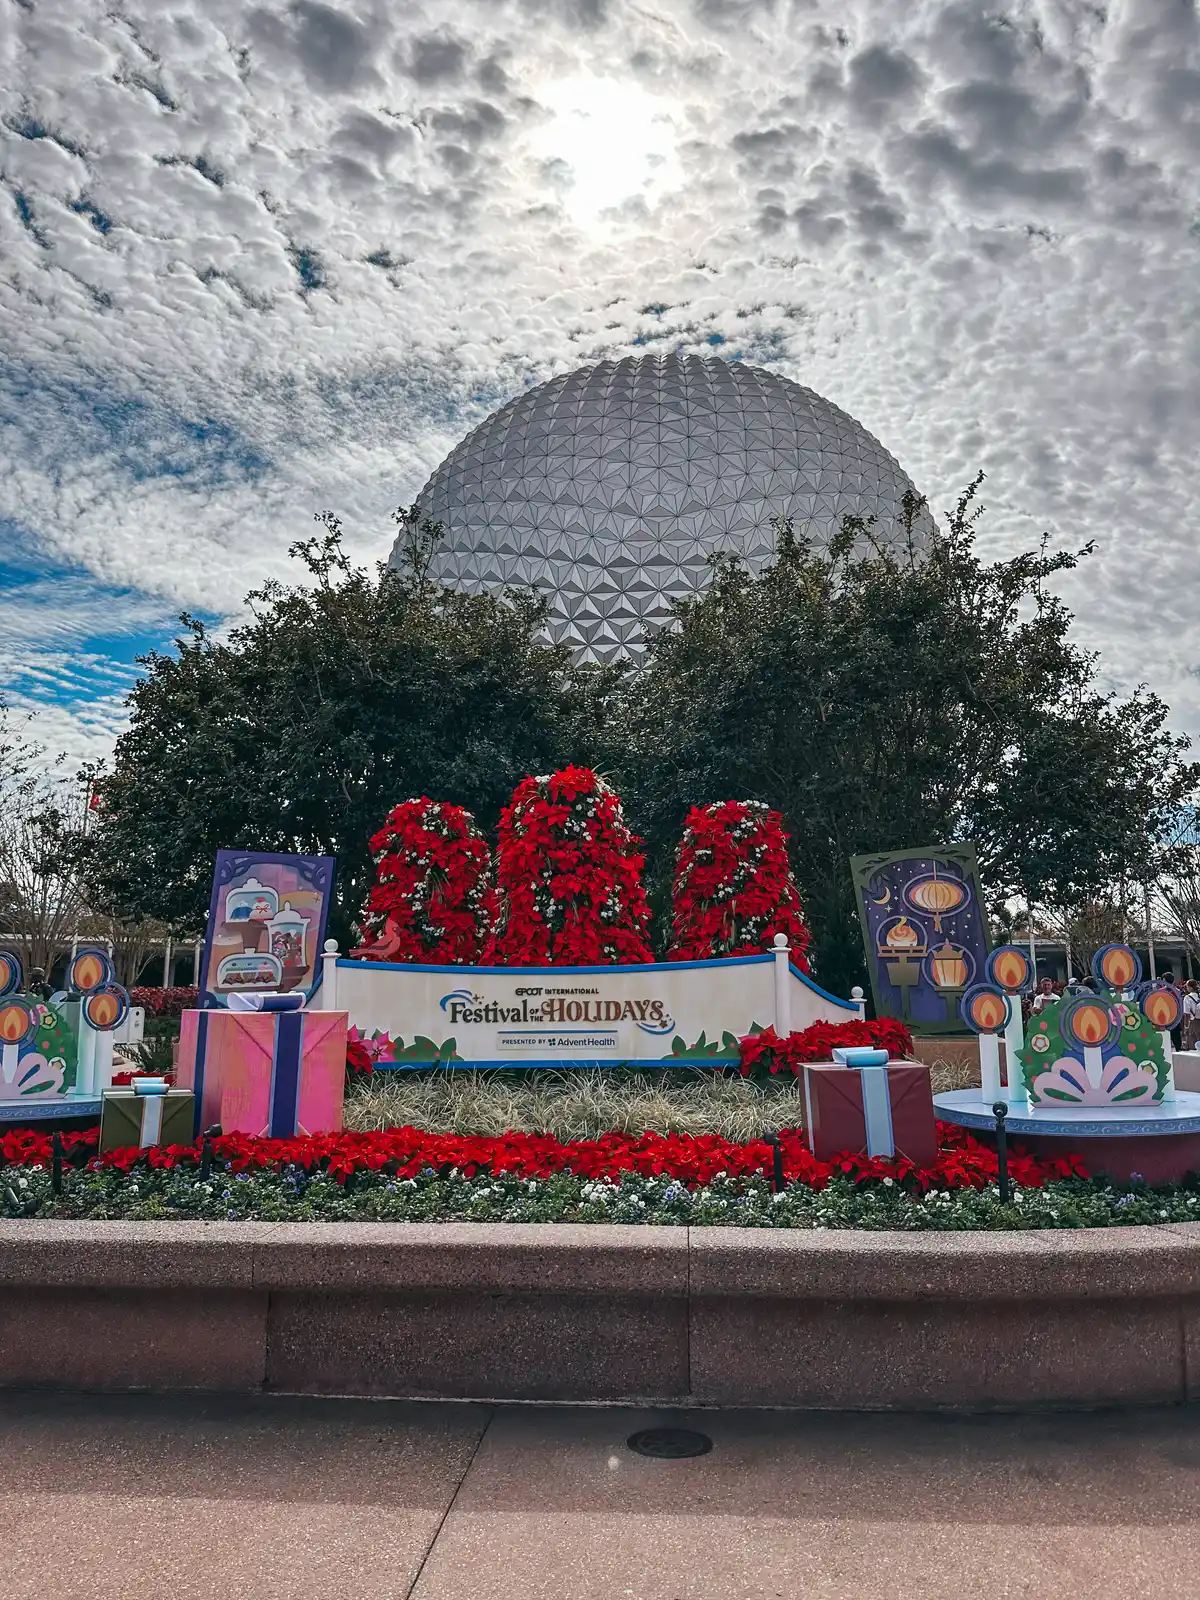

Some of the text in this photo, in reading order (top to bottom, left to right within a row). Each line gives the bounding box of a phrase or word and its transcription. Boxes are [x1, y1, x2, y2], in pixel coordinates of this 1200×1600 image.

[515, 987, 542, 996] EPCOT
[450, 999, 528, 1023] Festival
[541, 998, 663, 1022] HOLIDAYS
[558, 1038, 615, 1046] AdventHealth
